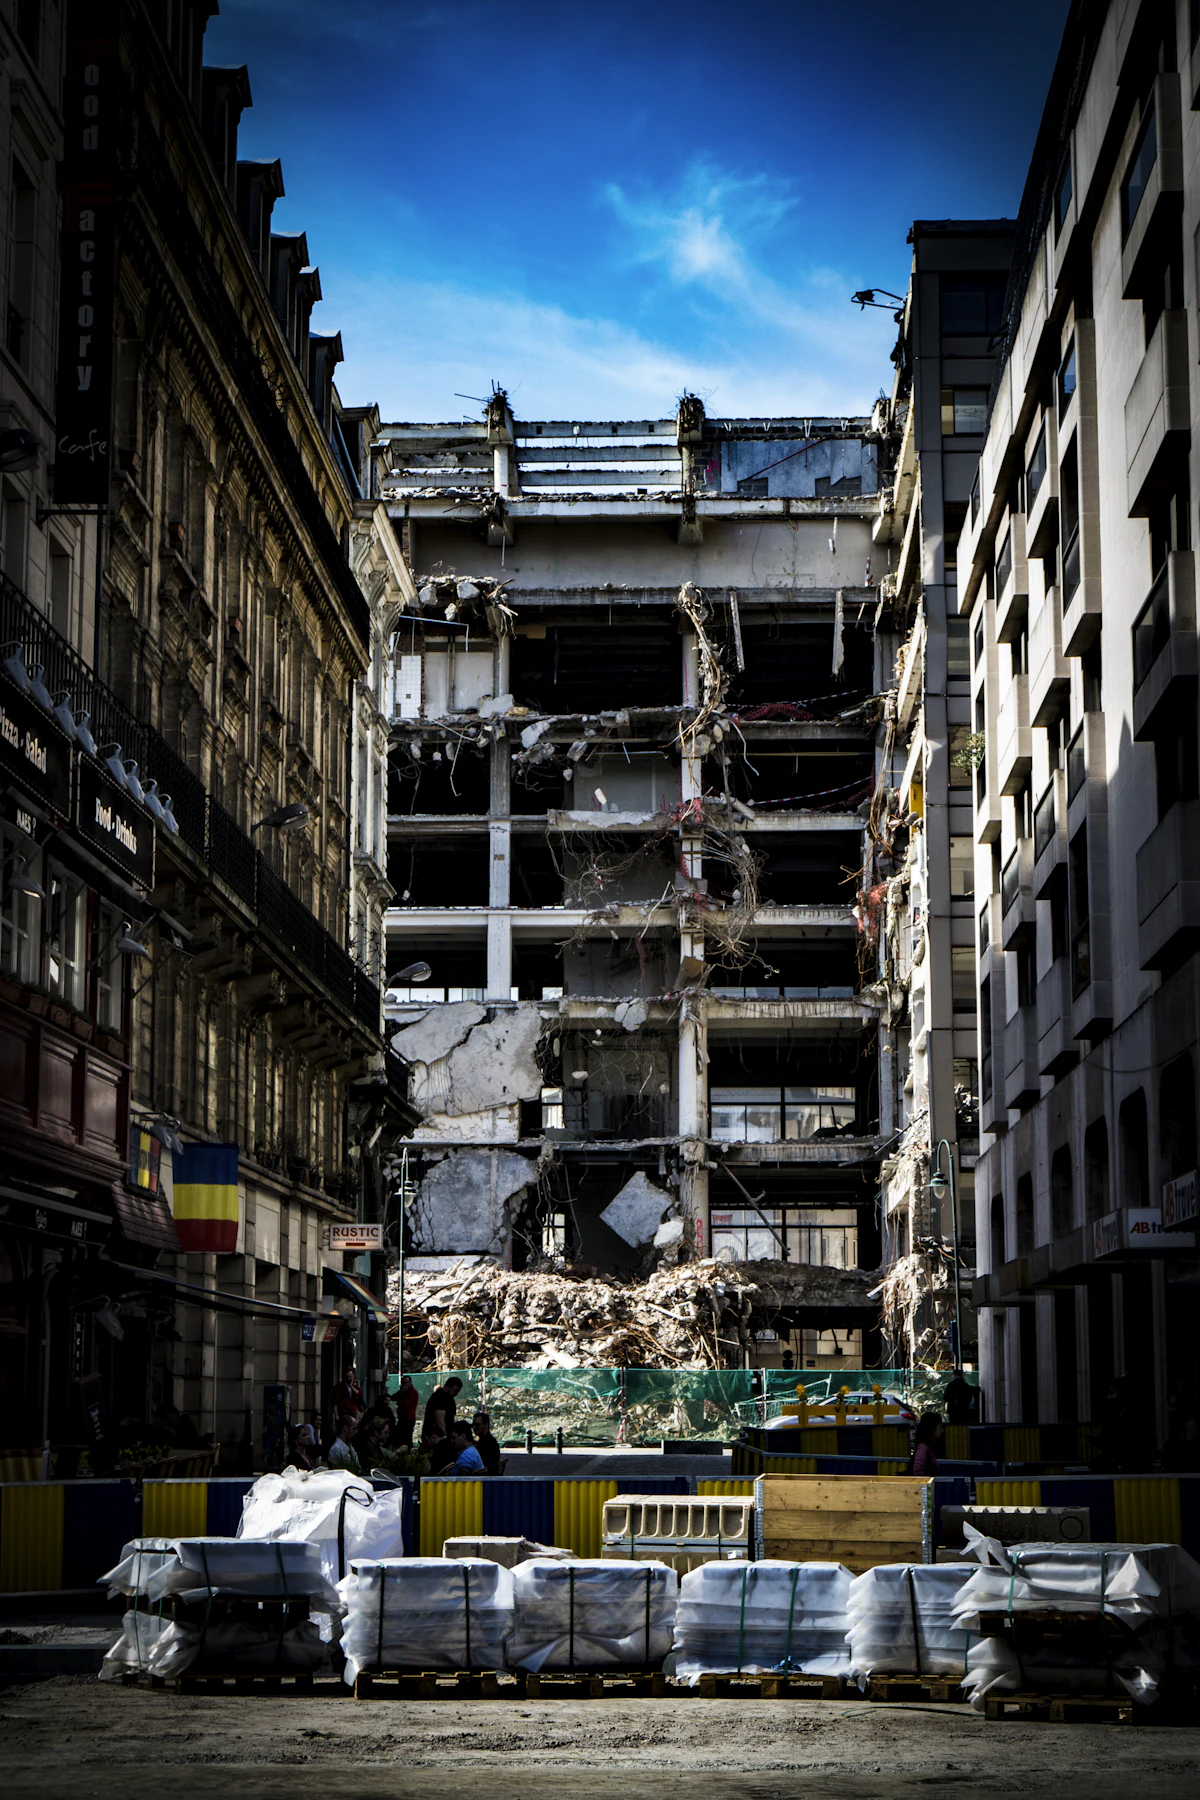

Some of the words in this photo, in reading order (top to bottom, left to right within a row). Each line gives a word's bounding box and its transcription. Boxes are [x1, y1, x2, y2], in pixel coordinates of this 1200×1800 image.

[64, 180, 117, 393] Factory
[25, 730, 47, 775] Salad
[95, 796, 112, 833] Food
[115, 813, 137, 856] Drinks
[332, 1227, 379, 1237] RUSTIC
[1130, 1222, 1150, 1234] AB
